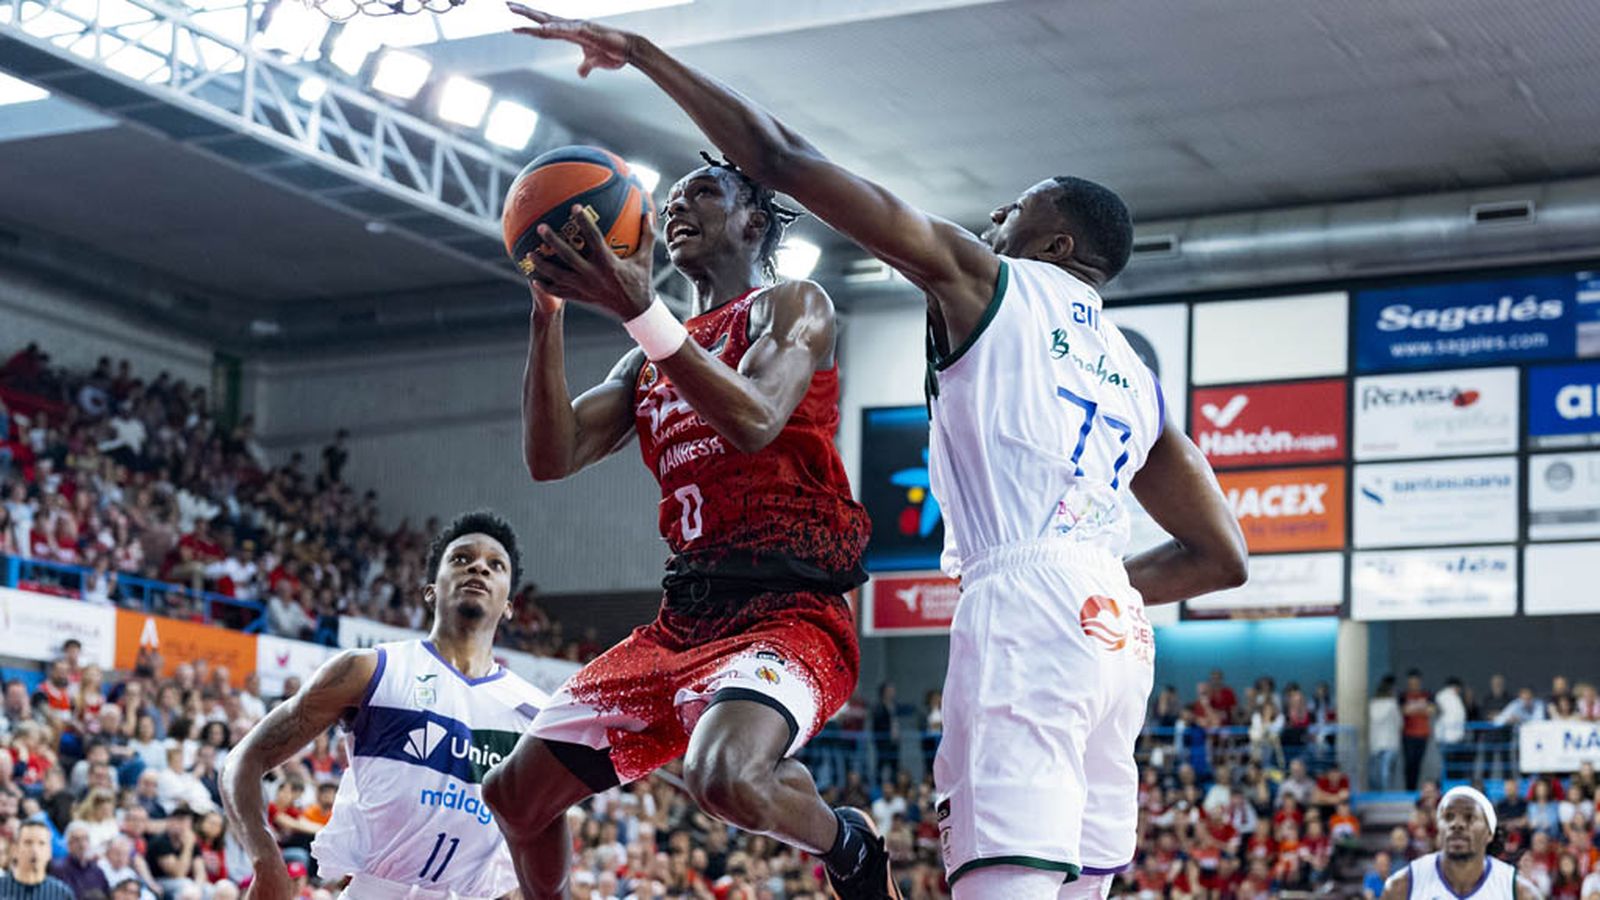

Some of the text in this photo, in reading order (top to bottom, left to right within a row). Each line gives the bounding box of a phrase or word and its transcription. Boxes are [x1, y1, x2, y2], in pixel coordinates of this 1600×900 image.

[1377, 296, 1562, 331] Sagalés
[1057, 385, 1132, 491] 77
[674, 483, 703, 541] 0
[451, 736, 505, 768] Unic
[419, 832, 460, 883] 11
